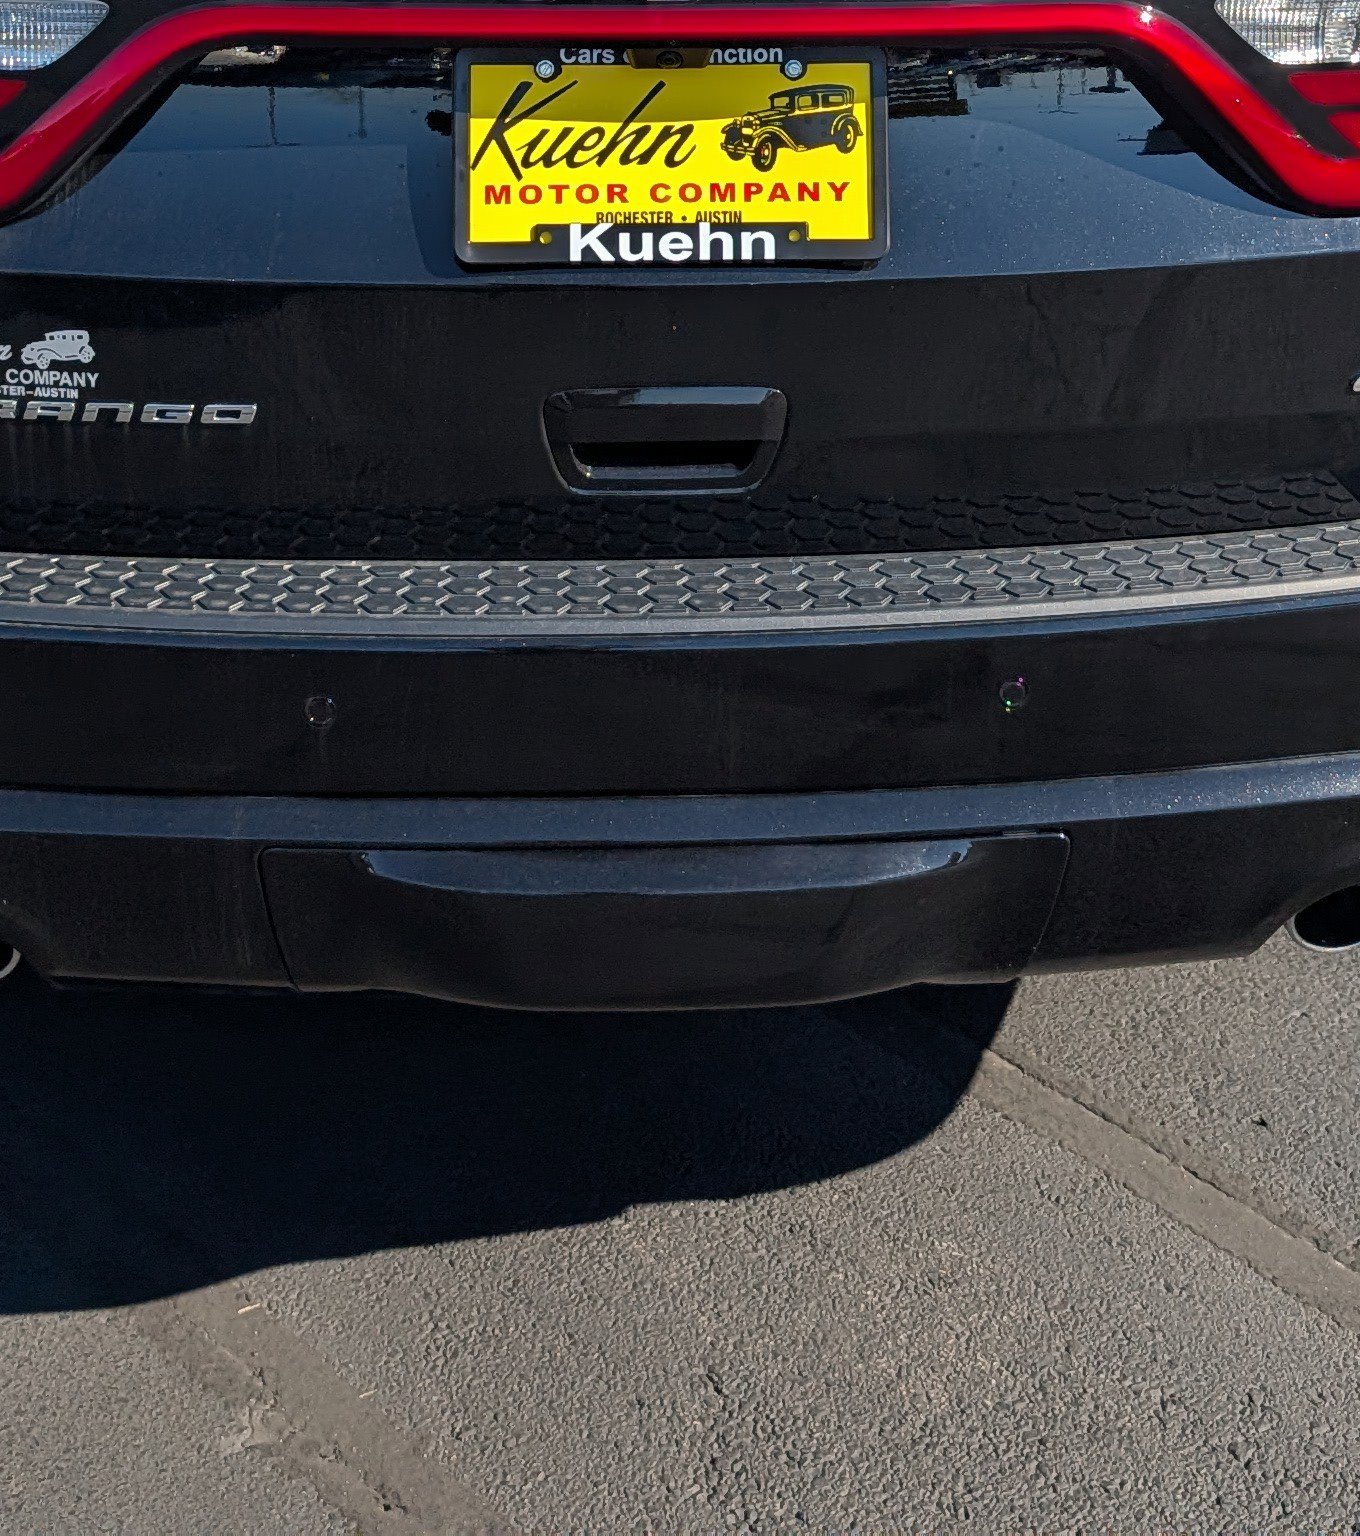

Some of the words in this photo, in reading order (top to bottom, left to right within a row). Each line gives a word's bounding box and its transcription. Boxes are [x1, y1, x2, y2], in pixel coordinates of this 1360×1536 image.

[559, 47, 615, 64] Cars
[471, 79, 697, 181] Kuehn
[483, 183, 628, 206] MOTOR
[649, 180, 851, 204] COMPANY
[596, 211, 674, 224] ROCHESTER
[695, 210, 743, 224] AUSTIN
[569, 221, 776, 262] Kuehn
[5, 368, 100, 389] COMPANY
